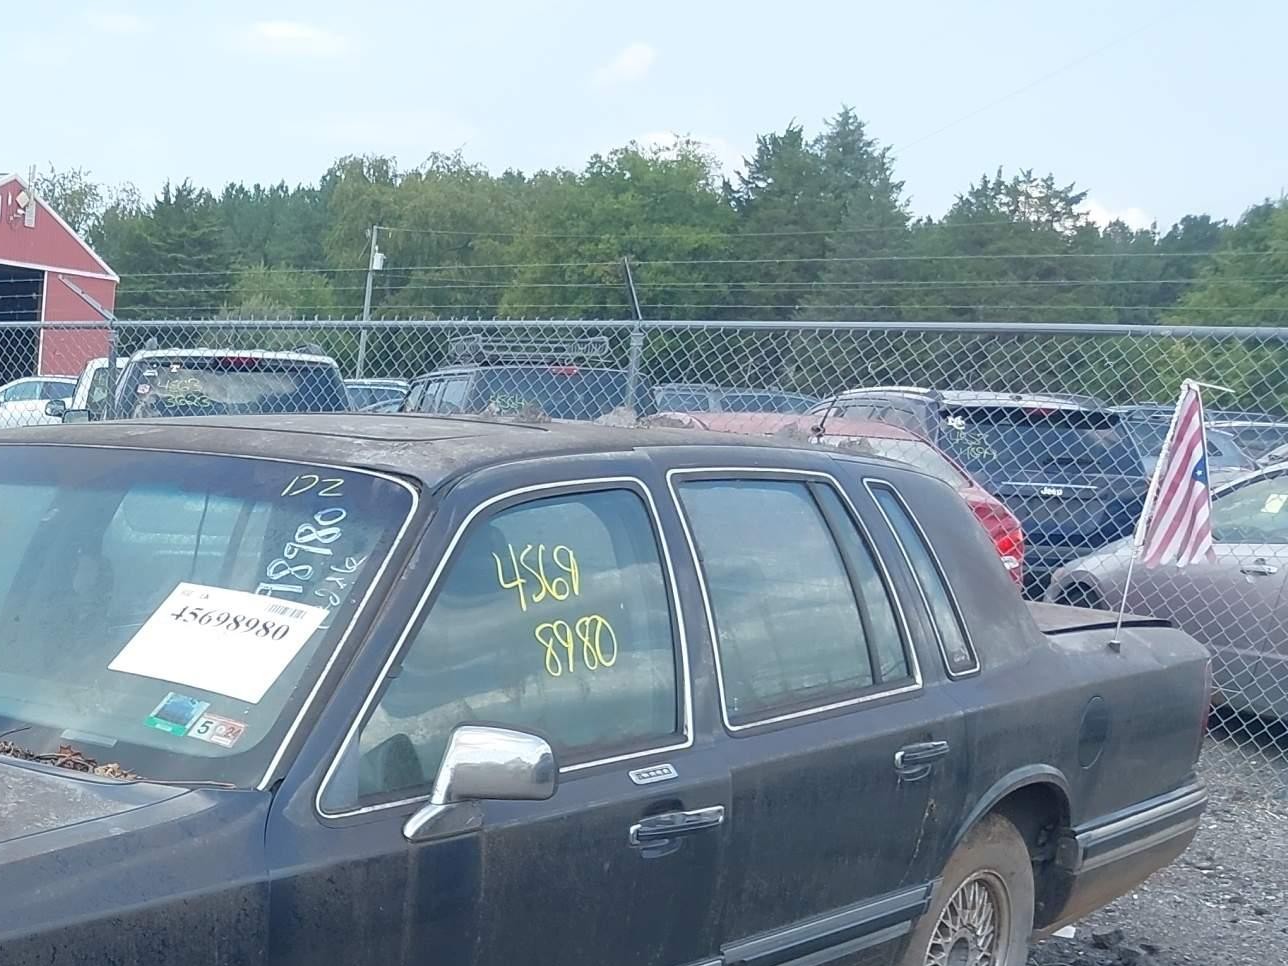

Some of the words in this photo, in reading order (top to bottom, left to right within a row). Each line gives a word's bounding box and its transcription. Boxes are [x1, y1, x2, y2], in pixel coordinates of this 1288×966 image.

[491, 543, 580, 612] 4569
[170, 605, 291, 641] 45698980
[534, 614, 618, 677] 8980
[197, 720, 214, 735] 5
